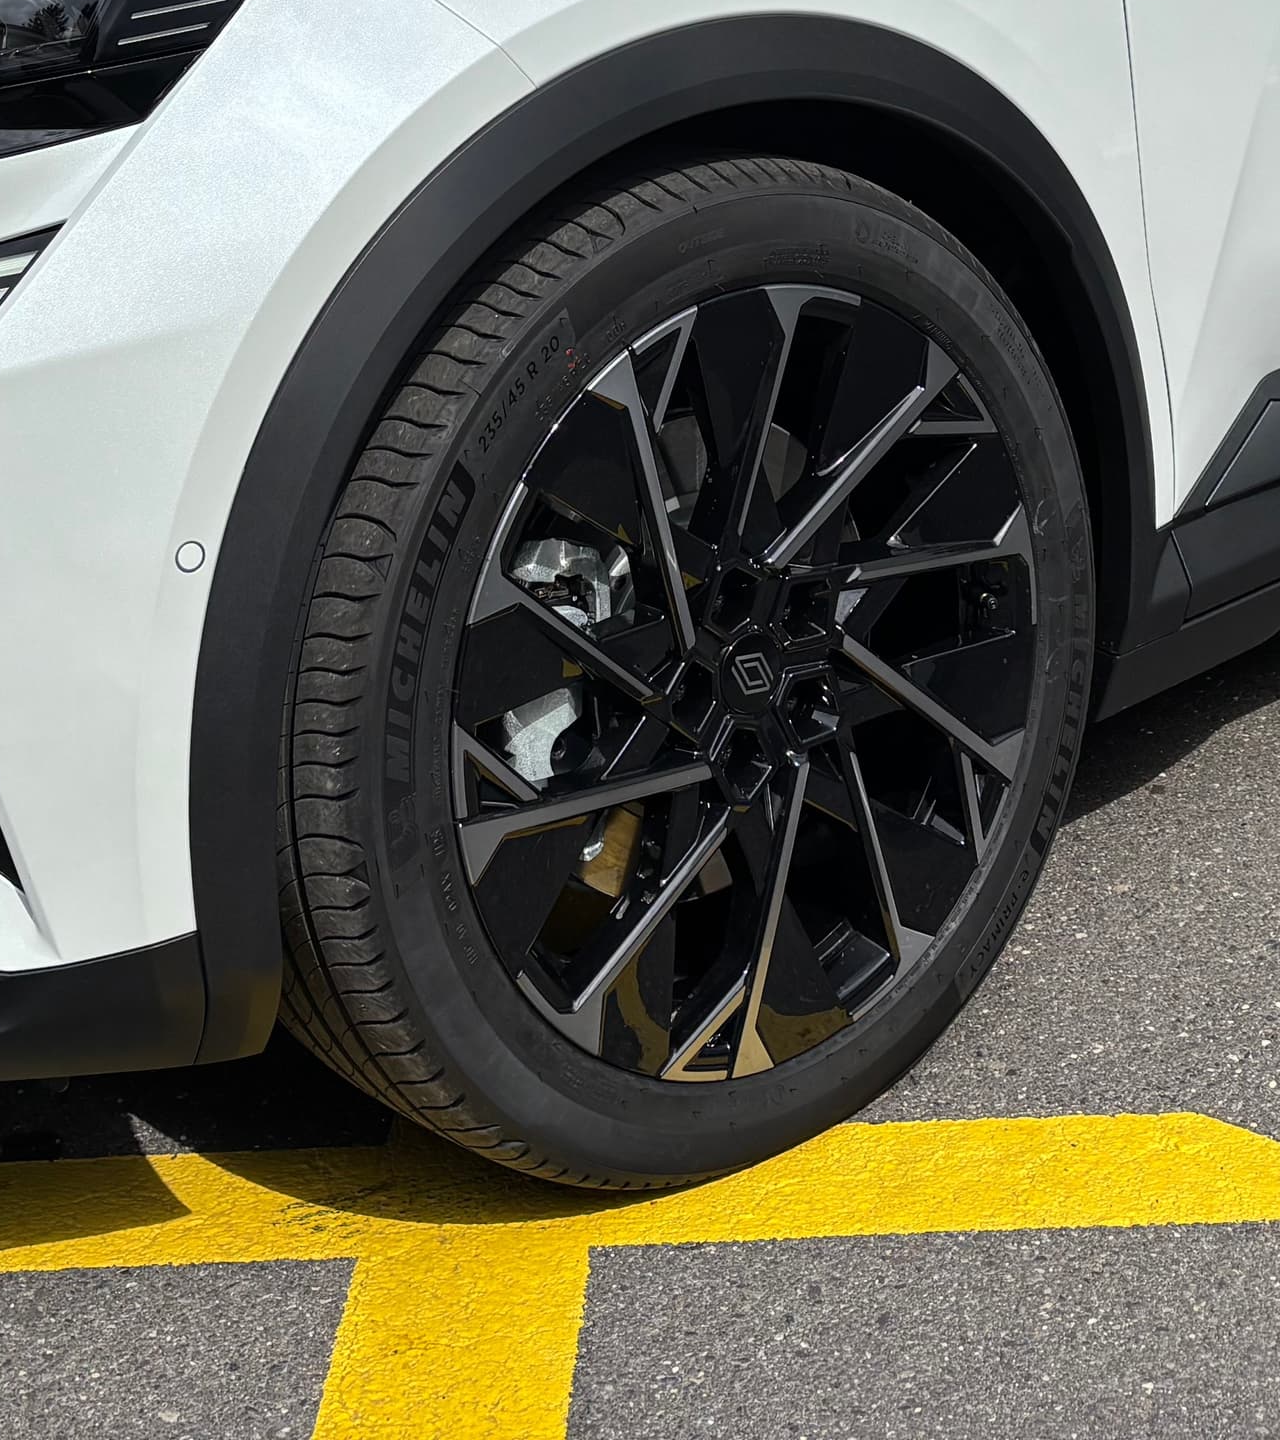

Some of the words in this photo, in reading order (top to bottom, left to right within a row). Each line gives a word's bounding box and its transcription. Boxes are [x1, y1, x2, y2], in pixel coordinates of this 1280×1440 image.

[478, 377, 525, 453] 235/45
[526, 361, 539, 380] R
[541, 335, 560, 363] 20
[386, 479, 466, 783] MICHELIN
